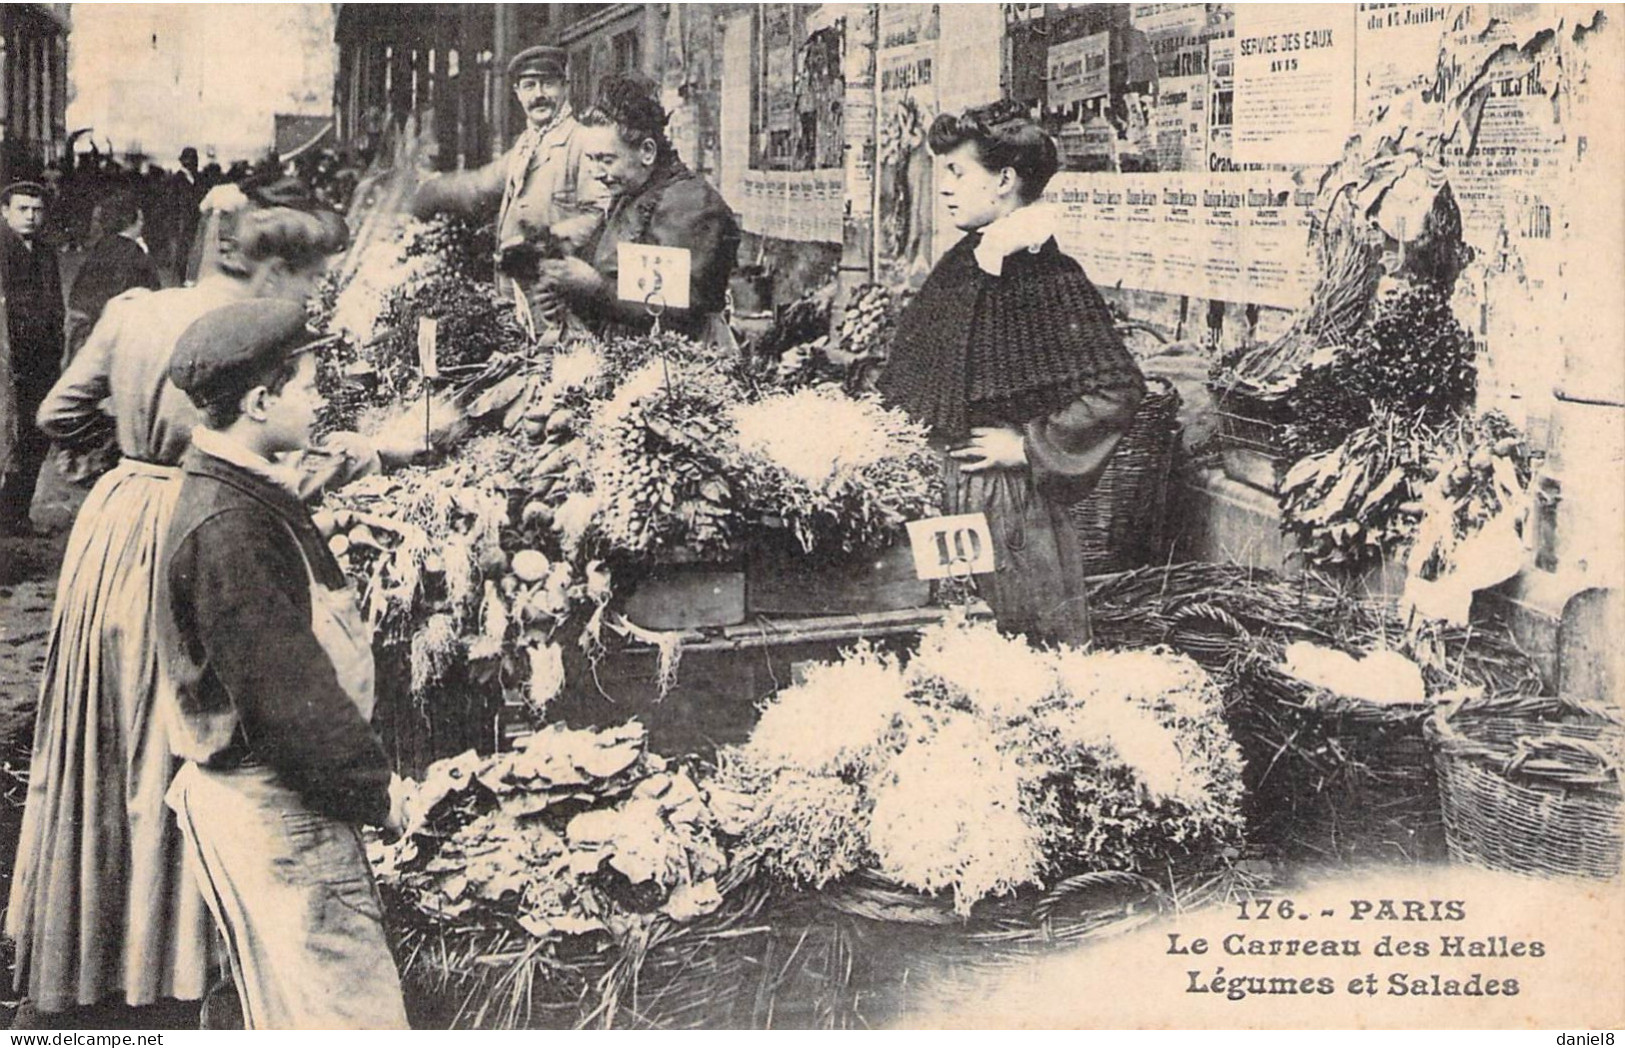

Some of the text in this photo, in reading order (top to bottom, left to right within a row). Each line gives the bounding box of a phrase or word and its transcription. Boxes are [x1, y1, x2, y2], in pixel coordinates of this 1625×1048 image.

[1240, 36, 1278, 56] SERVICE
[1281, 33, 1301, 52] DES
[1304, 29, 1334, 49] EAUX
[1270, 58, 1298, 73] AVIS
[934, 528, 981, 566] 10
